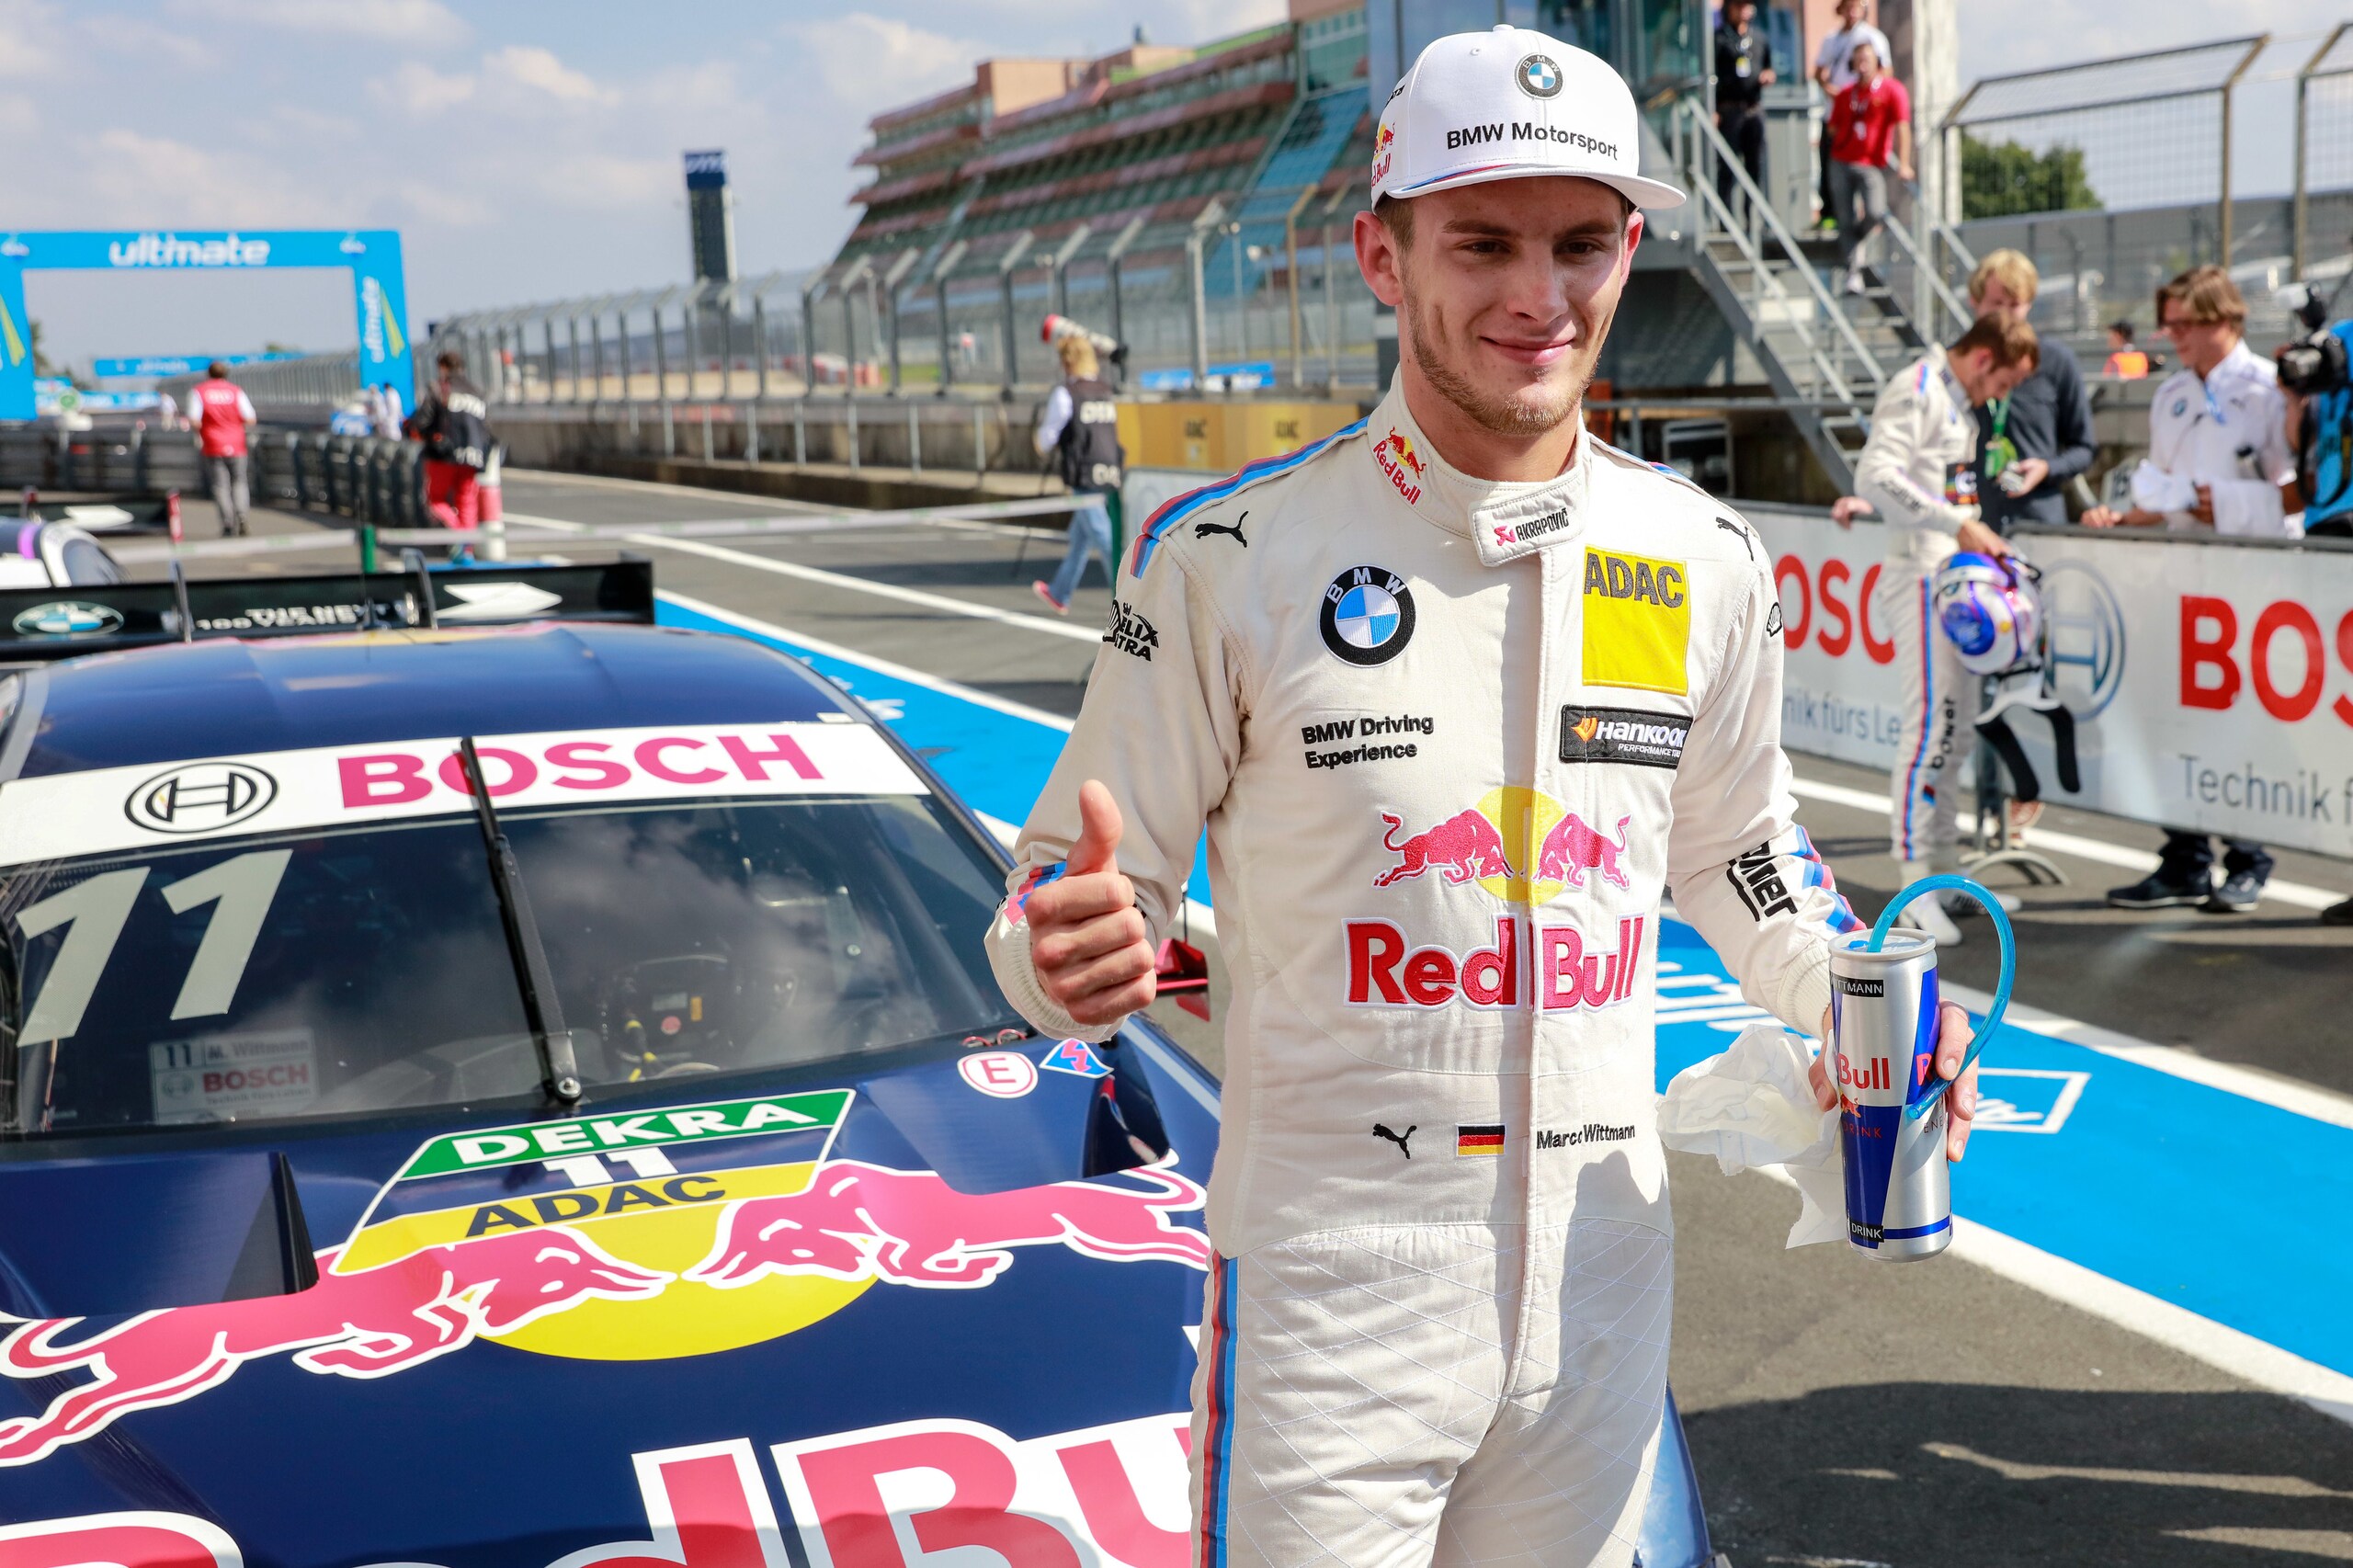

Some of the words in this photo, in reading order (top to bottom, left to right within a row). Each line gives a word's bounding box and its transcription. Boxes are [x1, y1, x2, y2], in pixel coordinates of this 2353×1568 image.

[1521, 55, 1561, 73] BMW
[1447, 122, 1504, 150] BMW
[1511, 122, 1618, 161] Motorsport
[108, 234, 271, 267] ultimate
[1373, 440, 1397, 477] Red
[1392, 468, 1421, 506] Bull
[1326, 567, 1406, 604] BMW
[1584, 552, 1684, 608] ADAC
[1776, 554, 1895, 665] OSC
[1114, 633, 1151, 662] TRA
[1118, 614, 1159, 648] ELIX
[1302, 720, 1356, 744] BMW
[1360, 714, 1434, 737] Driving
[1595, 721, 1688, 748] Hankook
[1305, 742, 1417, 769] Experience
[1618, 743, 1671, 756] PERFORMANCE
[336, 735, 824, 809] BOSCH
[2178, 753, 2333, 823] Technik
[16, 848, 293, 1047] 11
[1346, 916, 1518, 1007] Red
[1538, 915, 1645, 1010] Bull
[202, 1063, 310, 1093] BOSCH
[979, 1057, 1017, 1085] E
[1838, 1052, 1891, 1090] Bull
[452, 1102, 820, 1165] DEKRA
[1583, 1124, 1635, 1142] Wittmann
[1843, 1121, 1882, 1139] DRINK
[1924, 1116, 1944, 1134] ENE
[541, 1146, 679, 1187] 11
[464, 1176, 726, 1237] ADAC
[1851, 1222, 1882, 1239] DRINK
